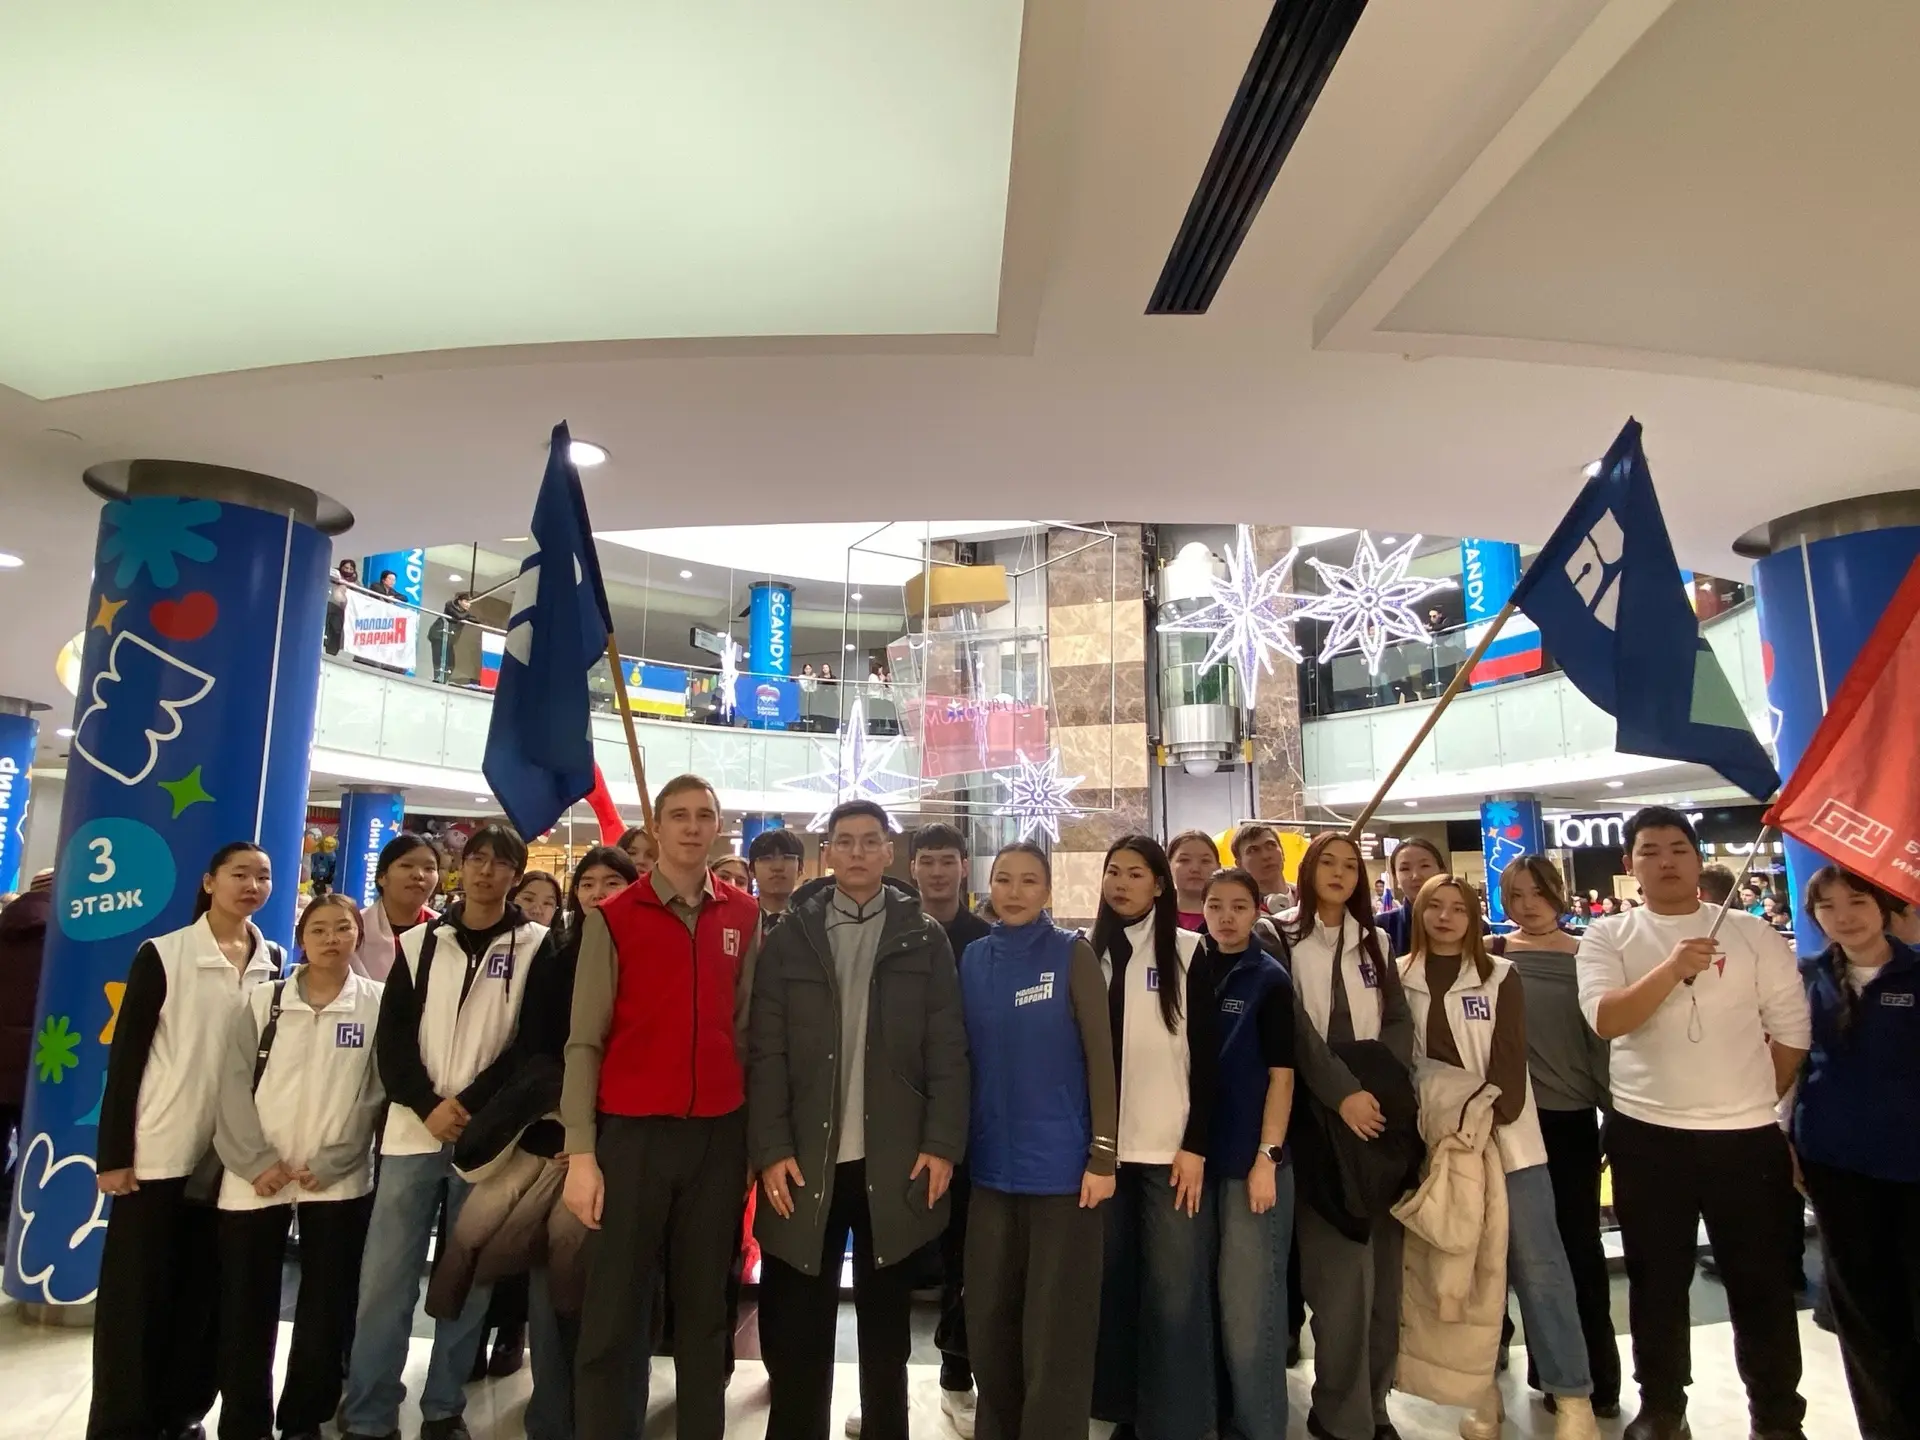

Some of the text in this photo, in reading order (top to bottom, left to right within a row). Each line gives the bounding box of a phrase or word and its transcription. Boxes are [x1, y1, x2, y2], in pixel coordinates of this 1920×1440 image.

[405, 548, 423, 601] NDY
[770, 591, 785, 671] SCANDY
[88, 837, 117, 883] 3
[364, 852, 380, 907] етский
[70, 888, 144, 919] этаж
